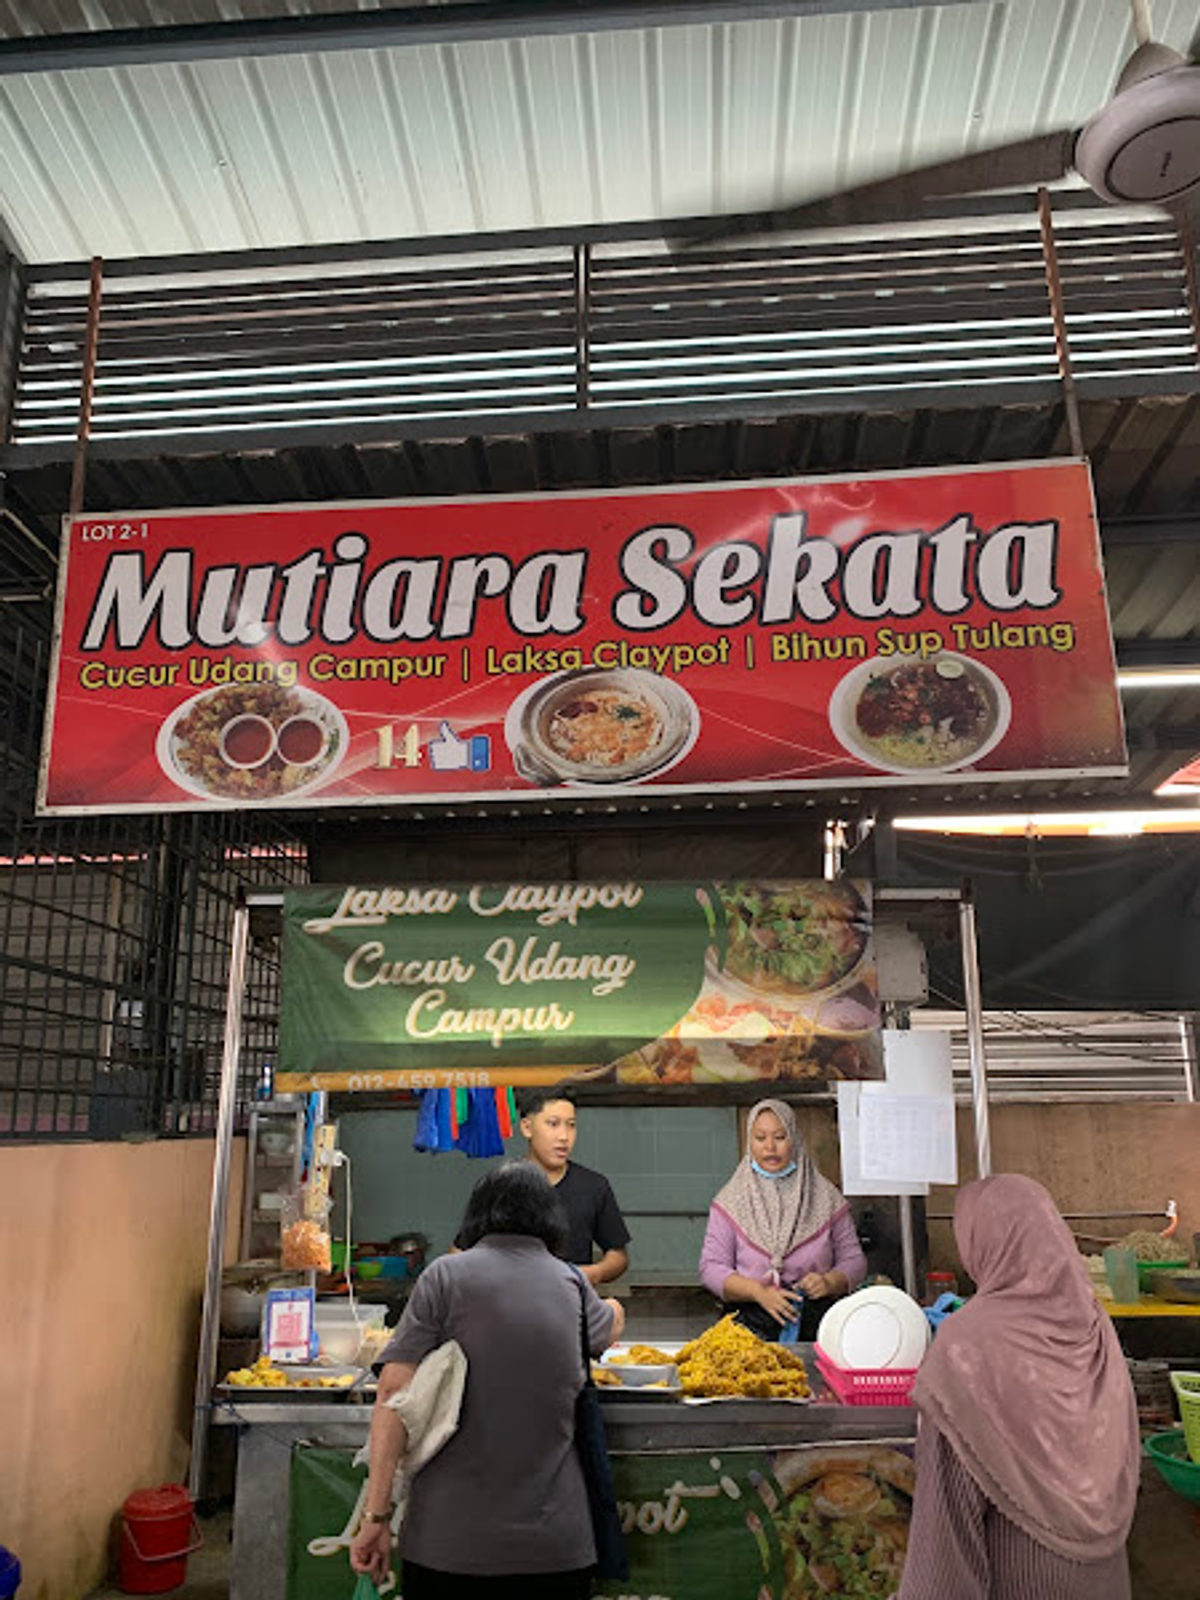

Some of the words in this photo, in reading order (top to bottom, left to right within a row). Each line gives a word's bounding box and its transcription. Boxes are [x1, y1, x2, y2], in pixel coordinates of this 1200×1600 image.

[82, 525, 115, 542] LOT
[81, 532, 588, 651] Mutiara
[613, 511, 1063, 632] Sekata
[80, 661, 180, 690] Cucur
[188, 656, 298, 688] Udang
[308, 653, 447, 685] Campur
[486, 644, 582, 673] Laksa
[593, 636, 731, 674] Claypot
[771, 632, 867, 662] Bihun
[876, 627, 943, 660] Sup
[952, 621, 1075, 652] Tulang
[343, 941, 476, 990] Cucur
[485, 936, 636, 996] Udang
[405, 988, 575, 1049] Campur
